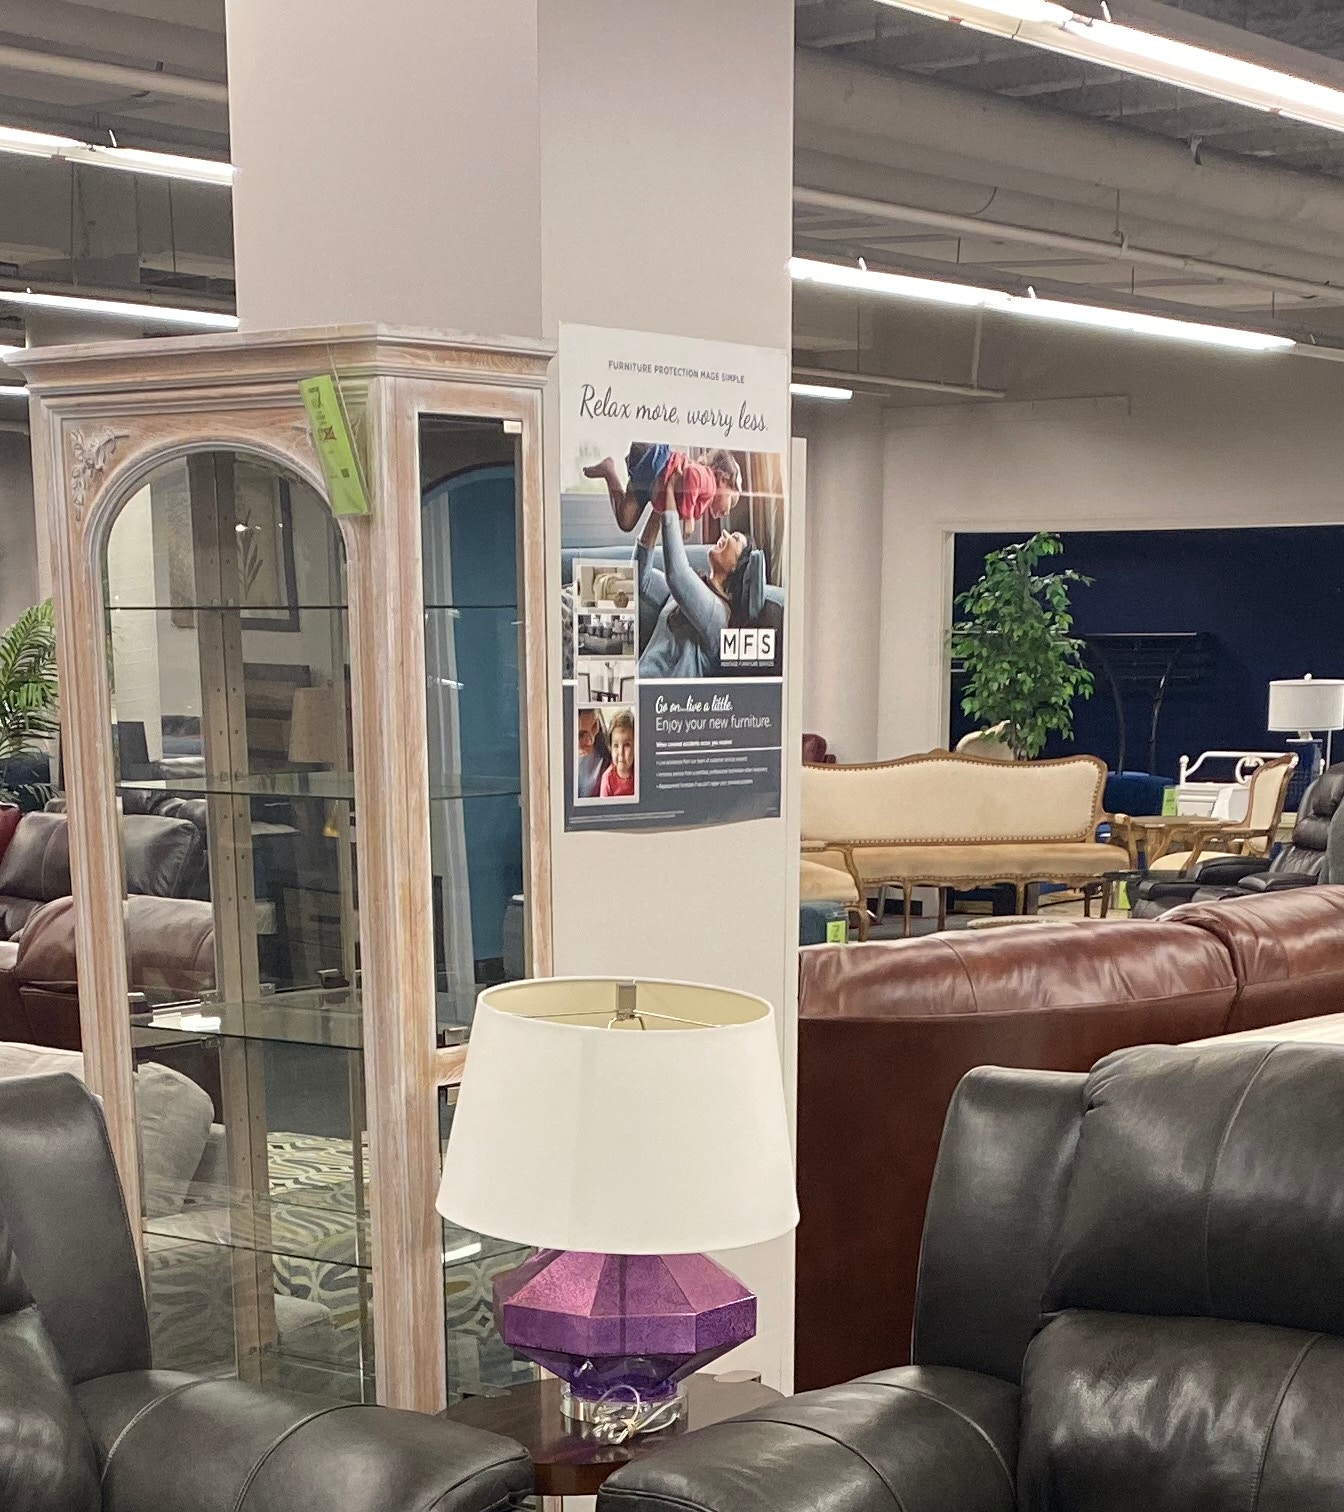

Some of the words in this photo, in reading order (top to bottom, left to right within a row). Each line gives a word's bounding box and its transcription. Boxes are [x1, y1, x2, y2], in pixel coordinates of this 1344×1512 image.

[608, 360, 652, 373] FURNITURE
[654, 365, 699, 378] PROTECTION
[701, 371, 719, 381] MADE
[580, 384, 631, 419] Relax
[636, 402, 680, 425] more,
[687, 408, 734, 437] worry
[738, 400, 769, 432] less.
[723, 634, 771, 655] MFS
[655, 695, 669, 714] Go
[711, 694, 733, 712] little.
[656, 717, 683, 734] Enjoy
[685, 718, 707, 733] your
[709, 717, 729, 730] new
[731, 713, 773, 729] furniture.
